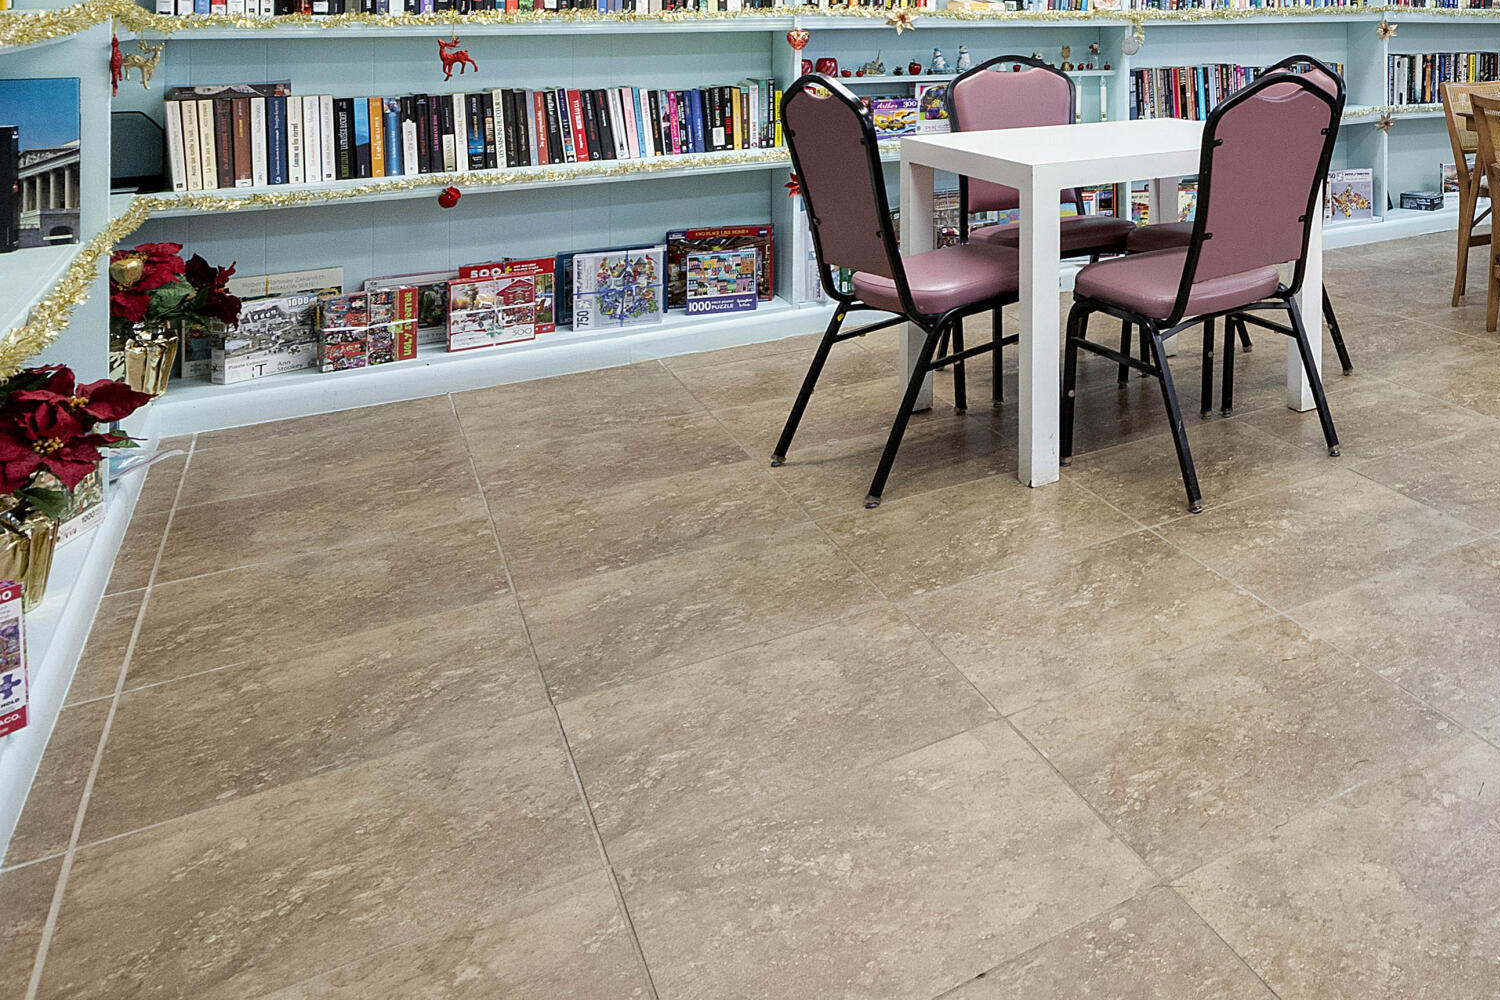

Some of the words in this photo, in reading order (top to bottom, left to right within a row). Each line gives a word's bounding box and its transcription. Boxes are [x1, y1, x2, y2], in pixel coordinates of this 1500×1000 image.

[903, 100, 917, 108] 300
[470, 268, 502, 278] 500
[288, 296, 308, 306] 1000
[689, 301, 711, 312] 1000
[577, 311, 589, 328] 750
[404, 333, 412, 356] UGLY
